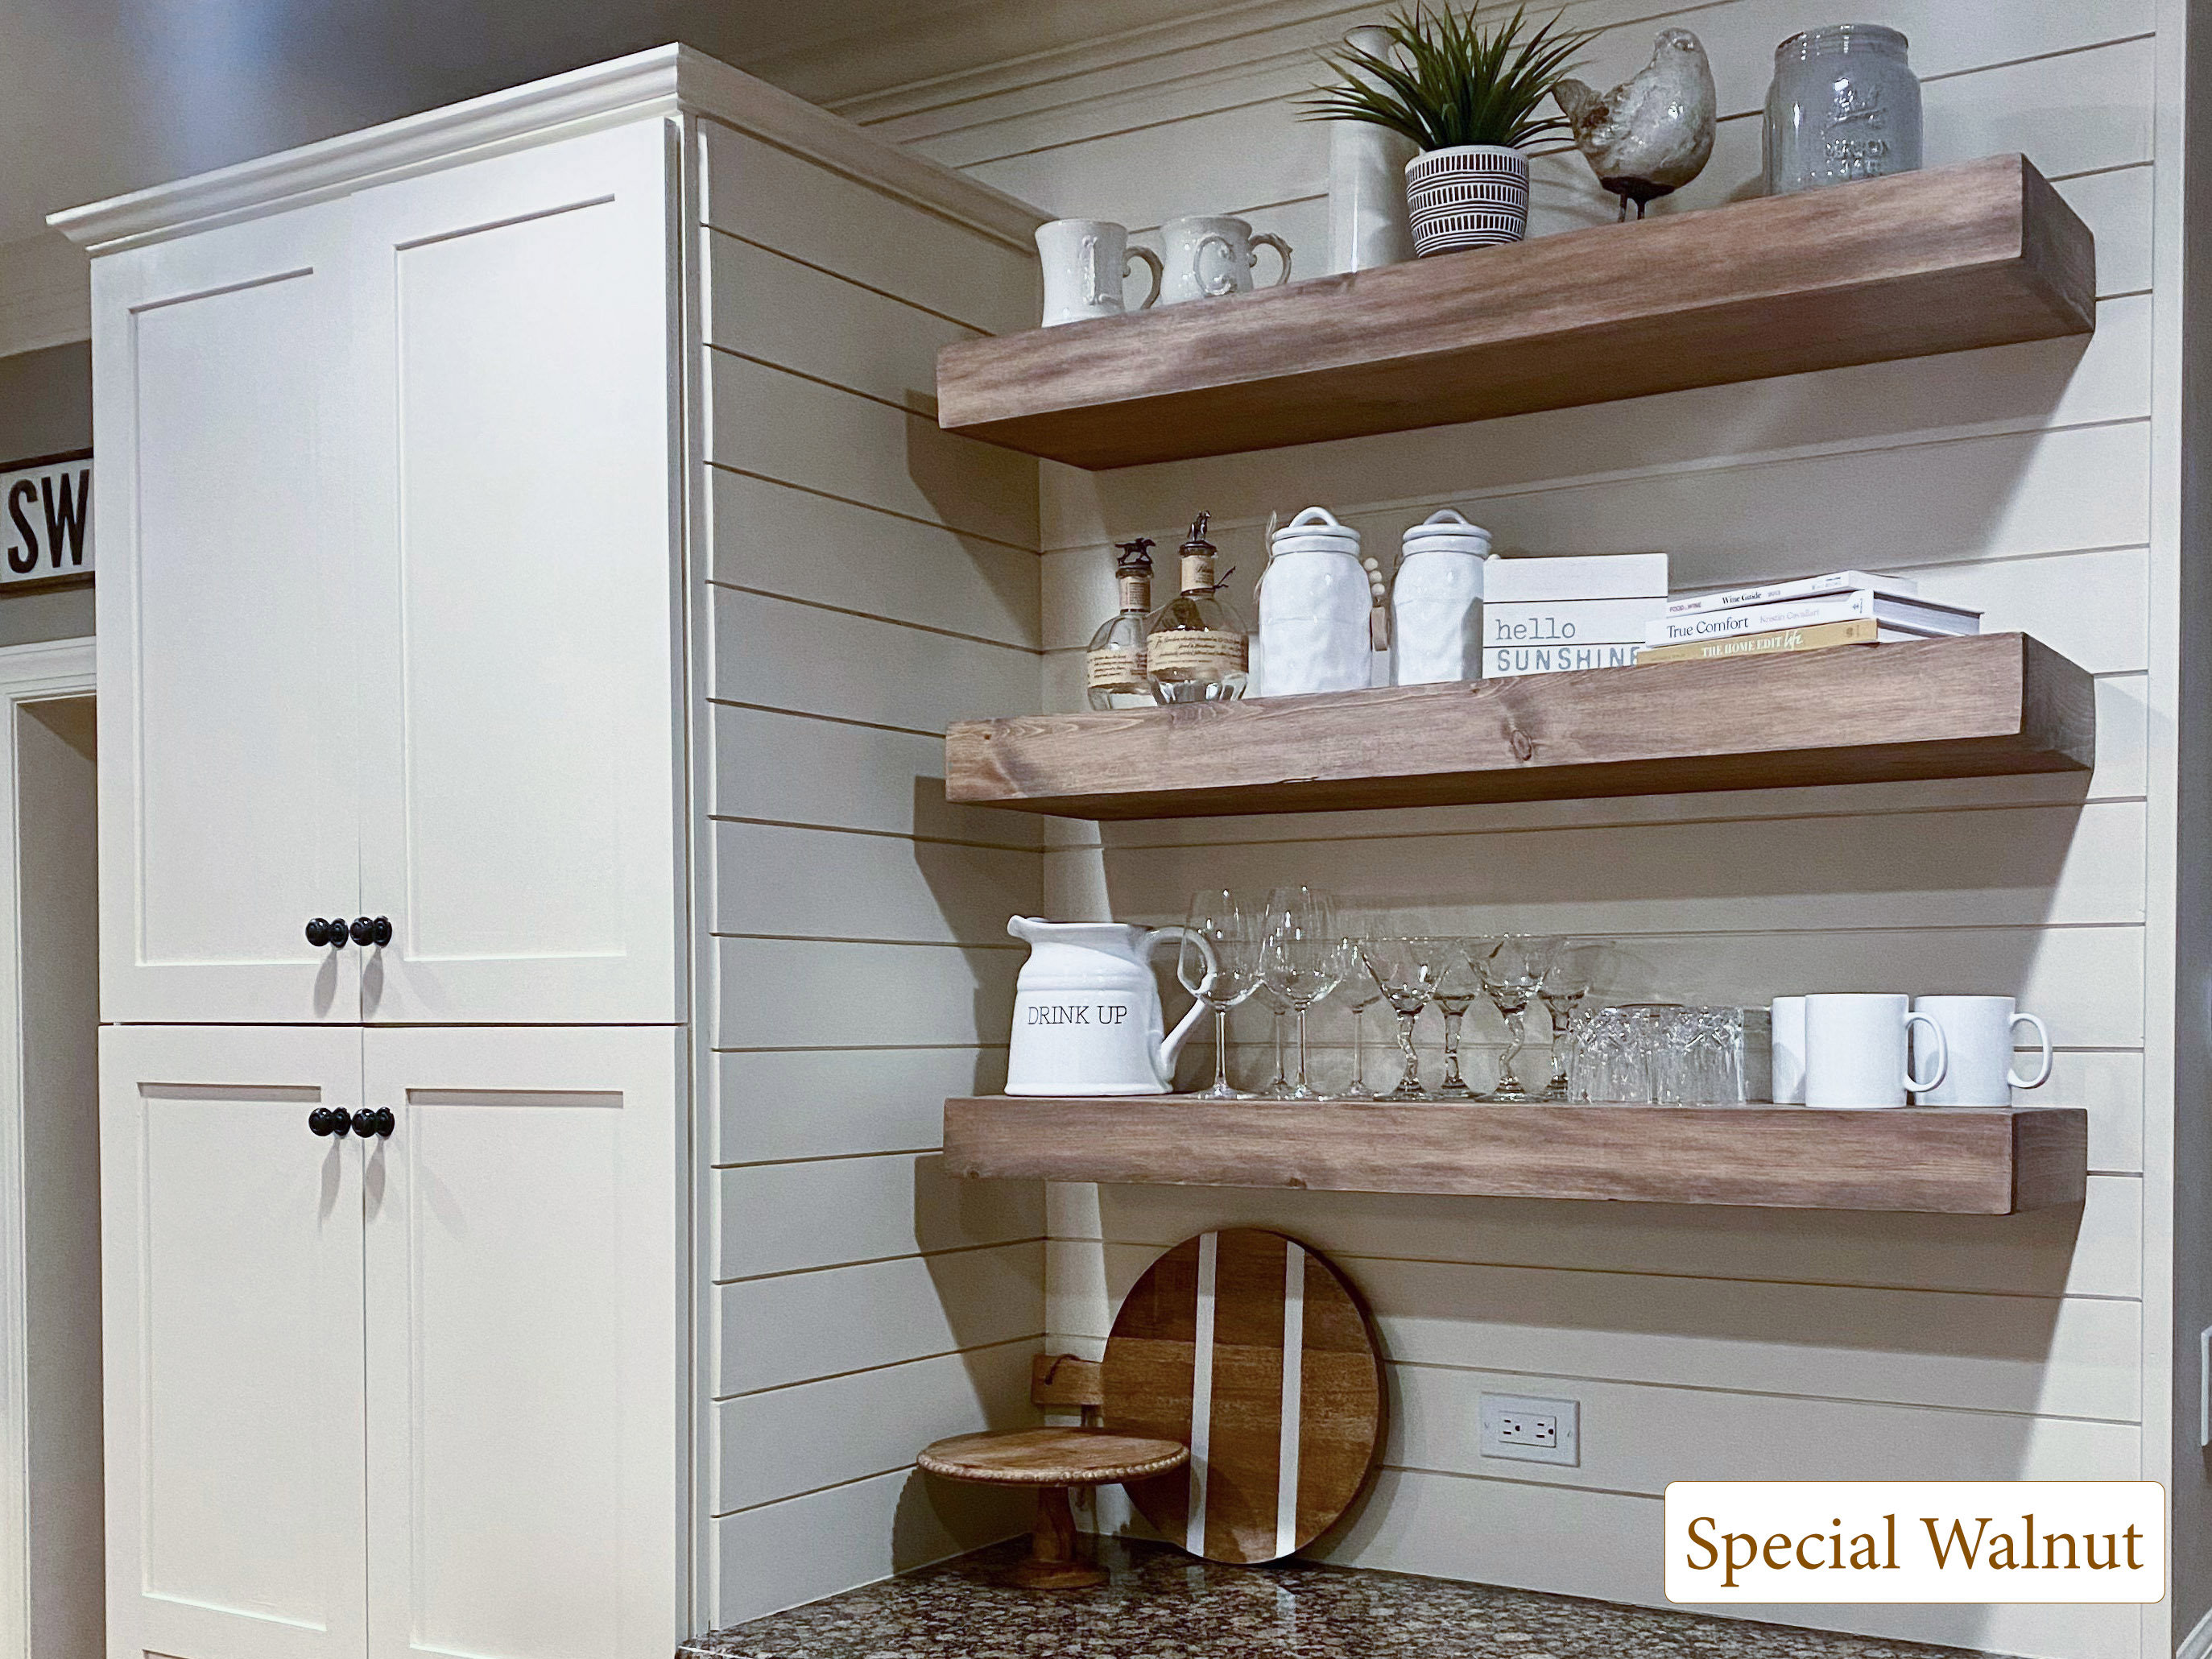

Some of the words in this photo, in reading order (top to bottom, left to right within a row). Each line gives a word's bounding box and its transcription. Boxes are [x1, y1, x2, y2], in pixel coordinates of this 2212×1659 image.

[8, 469, 90, 573] SW
[1722, 595, 1740, 605] Wine
[1495, 617, 1576, 640] hello
[1666, 623, 1693, 639] True
[1696, 616, 1749, 635] Comfort
[1701, 646, 1723, 658] THE
[1723, 641, 1757, 655] HOME
[1757, 636, 1783, 650] EDIT
[1783, 629, 1804, 651] life
[1027, 1006, 1089, 1024] DRINK
[1097, 1006, 1127, 1024] UP
